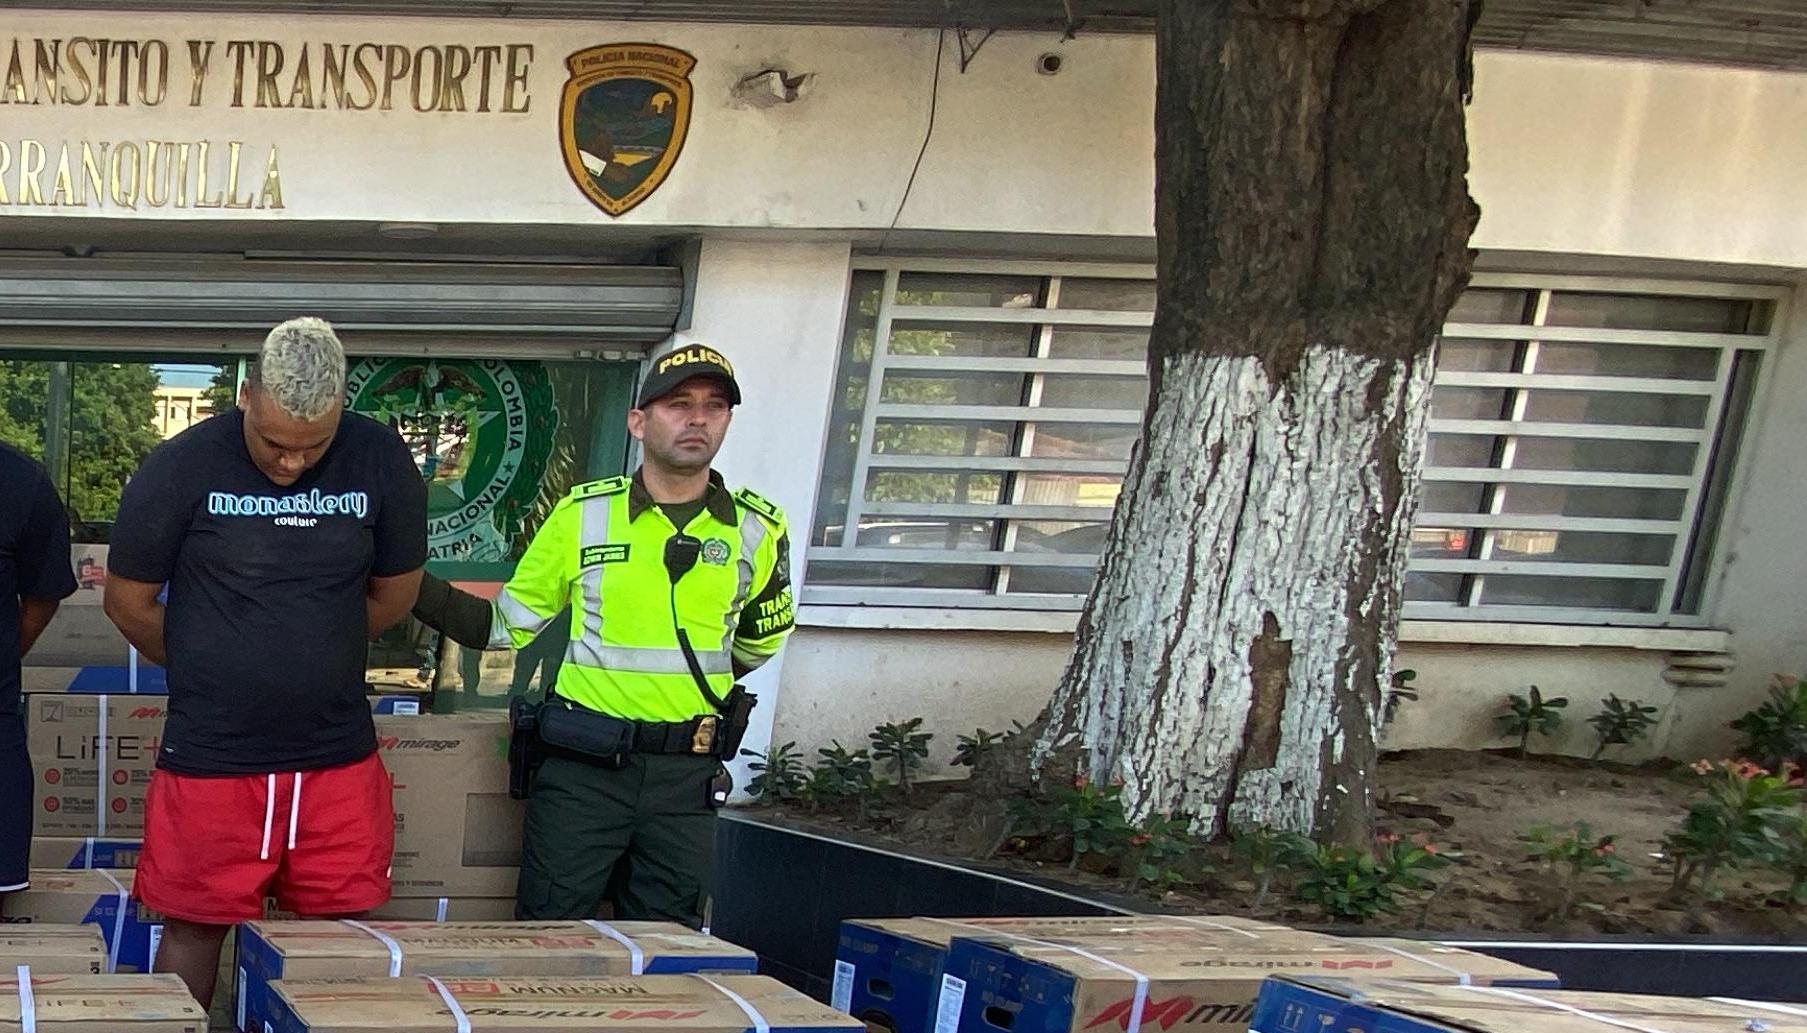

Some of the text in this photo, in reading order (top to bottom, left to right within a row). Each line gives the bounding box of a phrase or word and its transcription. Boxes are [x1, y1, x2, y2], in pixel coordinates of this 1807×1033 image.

[187, 40, 215, 107] Y
[226, 42, 535, 114] TRANSPORTE
[658, 349, 733, 375] POLICIA
[207, 488, 368, 518] monastery
[427, 533, 483, 560] ATRIA
[396, 737, 462, 752] mirage
